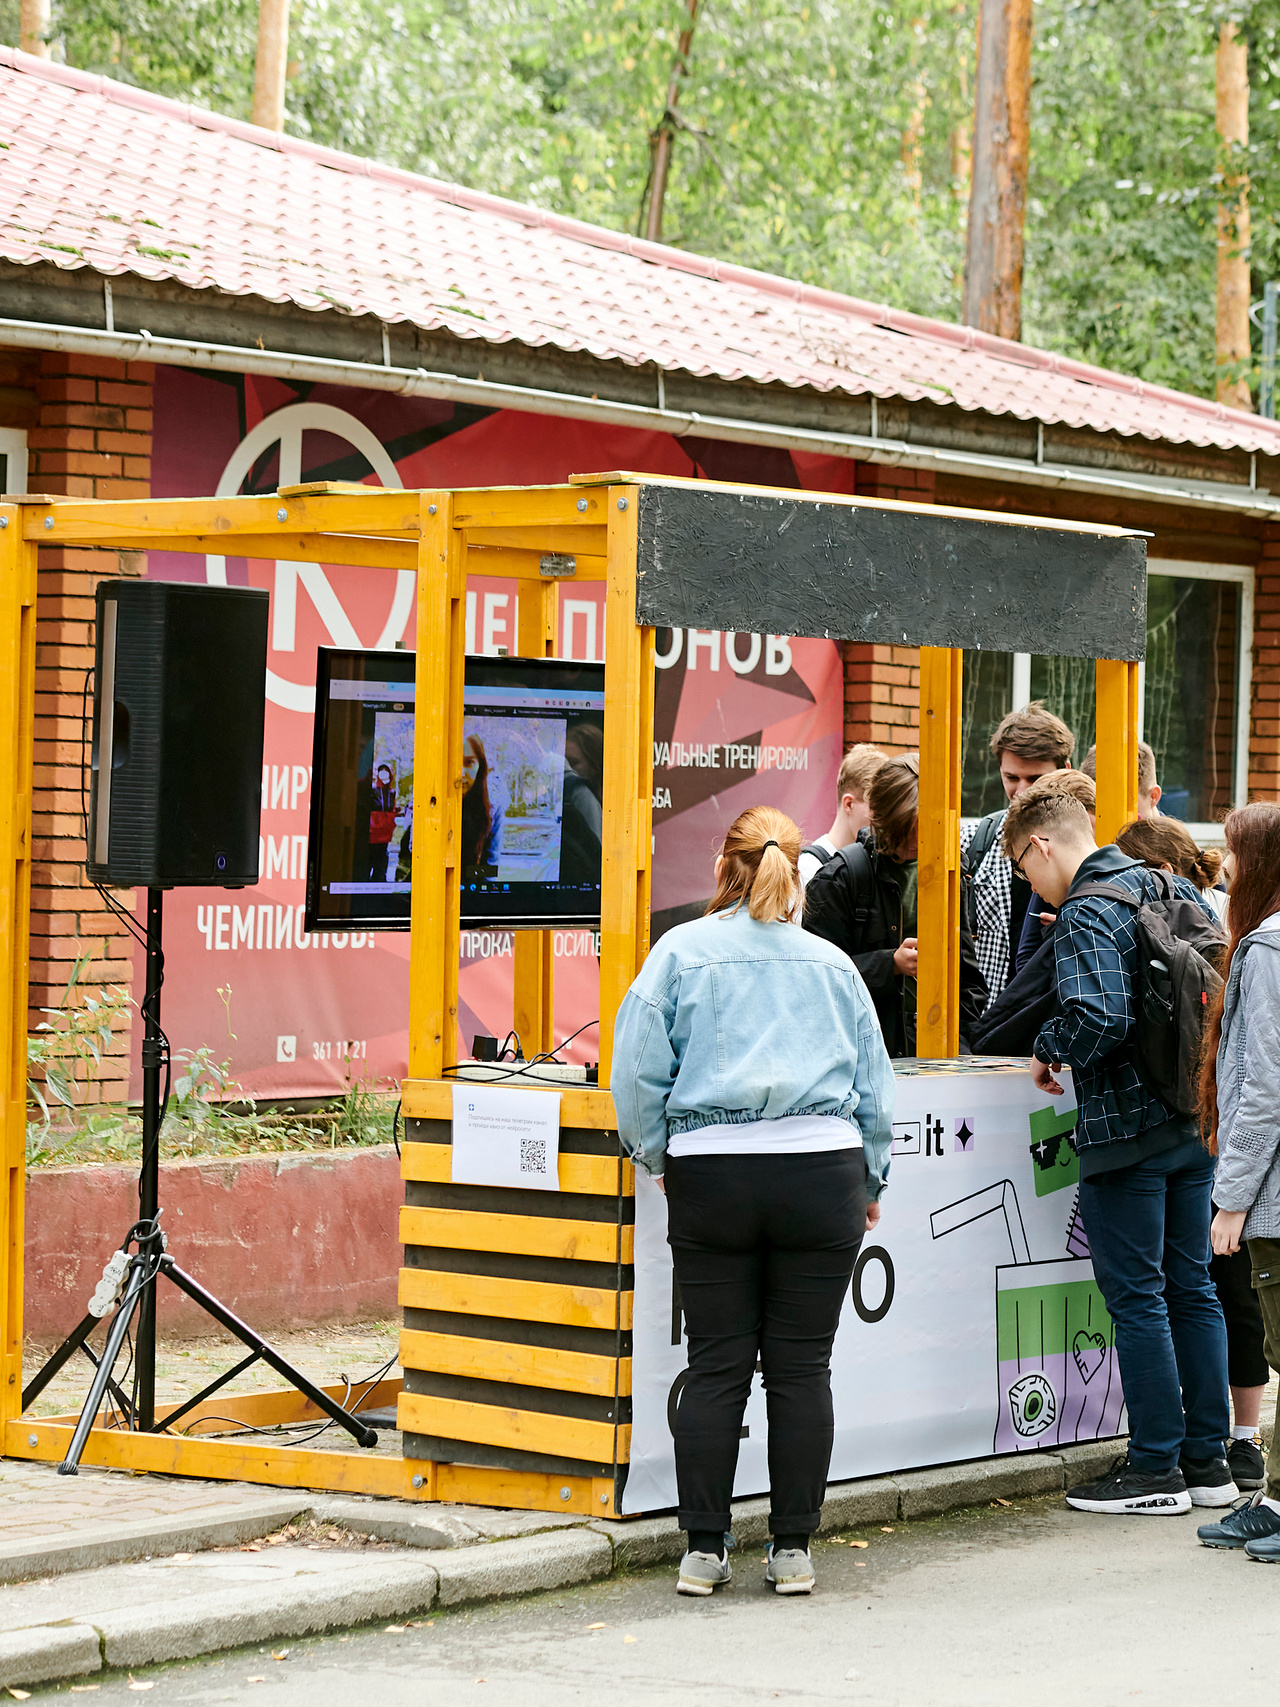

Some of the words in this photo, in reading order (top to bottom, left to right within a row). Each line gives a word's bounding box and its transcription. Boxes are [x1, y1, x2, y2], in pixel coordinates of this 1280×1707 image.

[652, 741, 721, 769] УАЛЬНЫЕ
[722, 743, 808, 771] ТРЕНИРОВКИ
[460, 931, 515, 958] ПРОКА
[312, 1041, 332, 1061] 361
[336, 1040, 349, 1060] 11
[352, 1040, 367, 1059] 21
[925, 1113, 945, 1157] it
